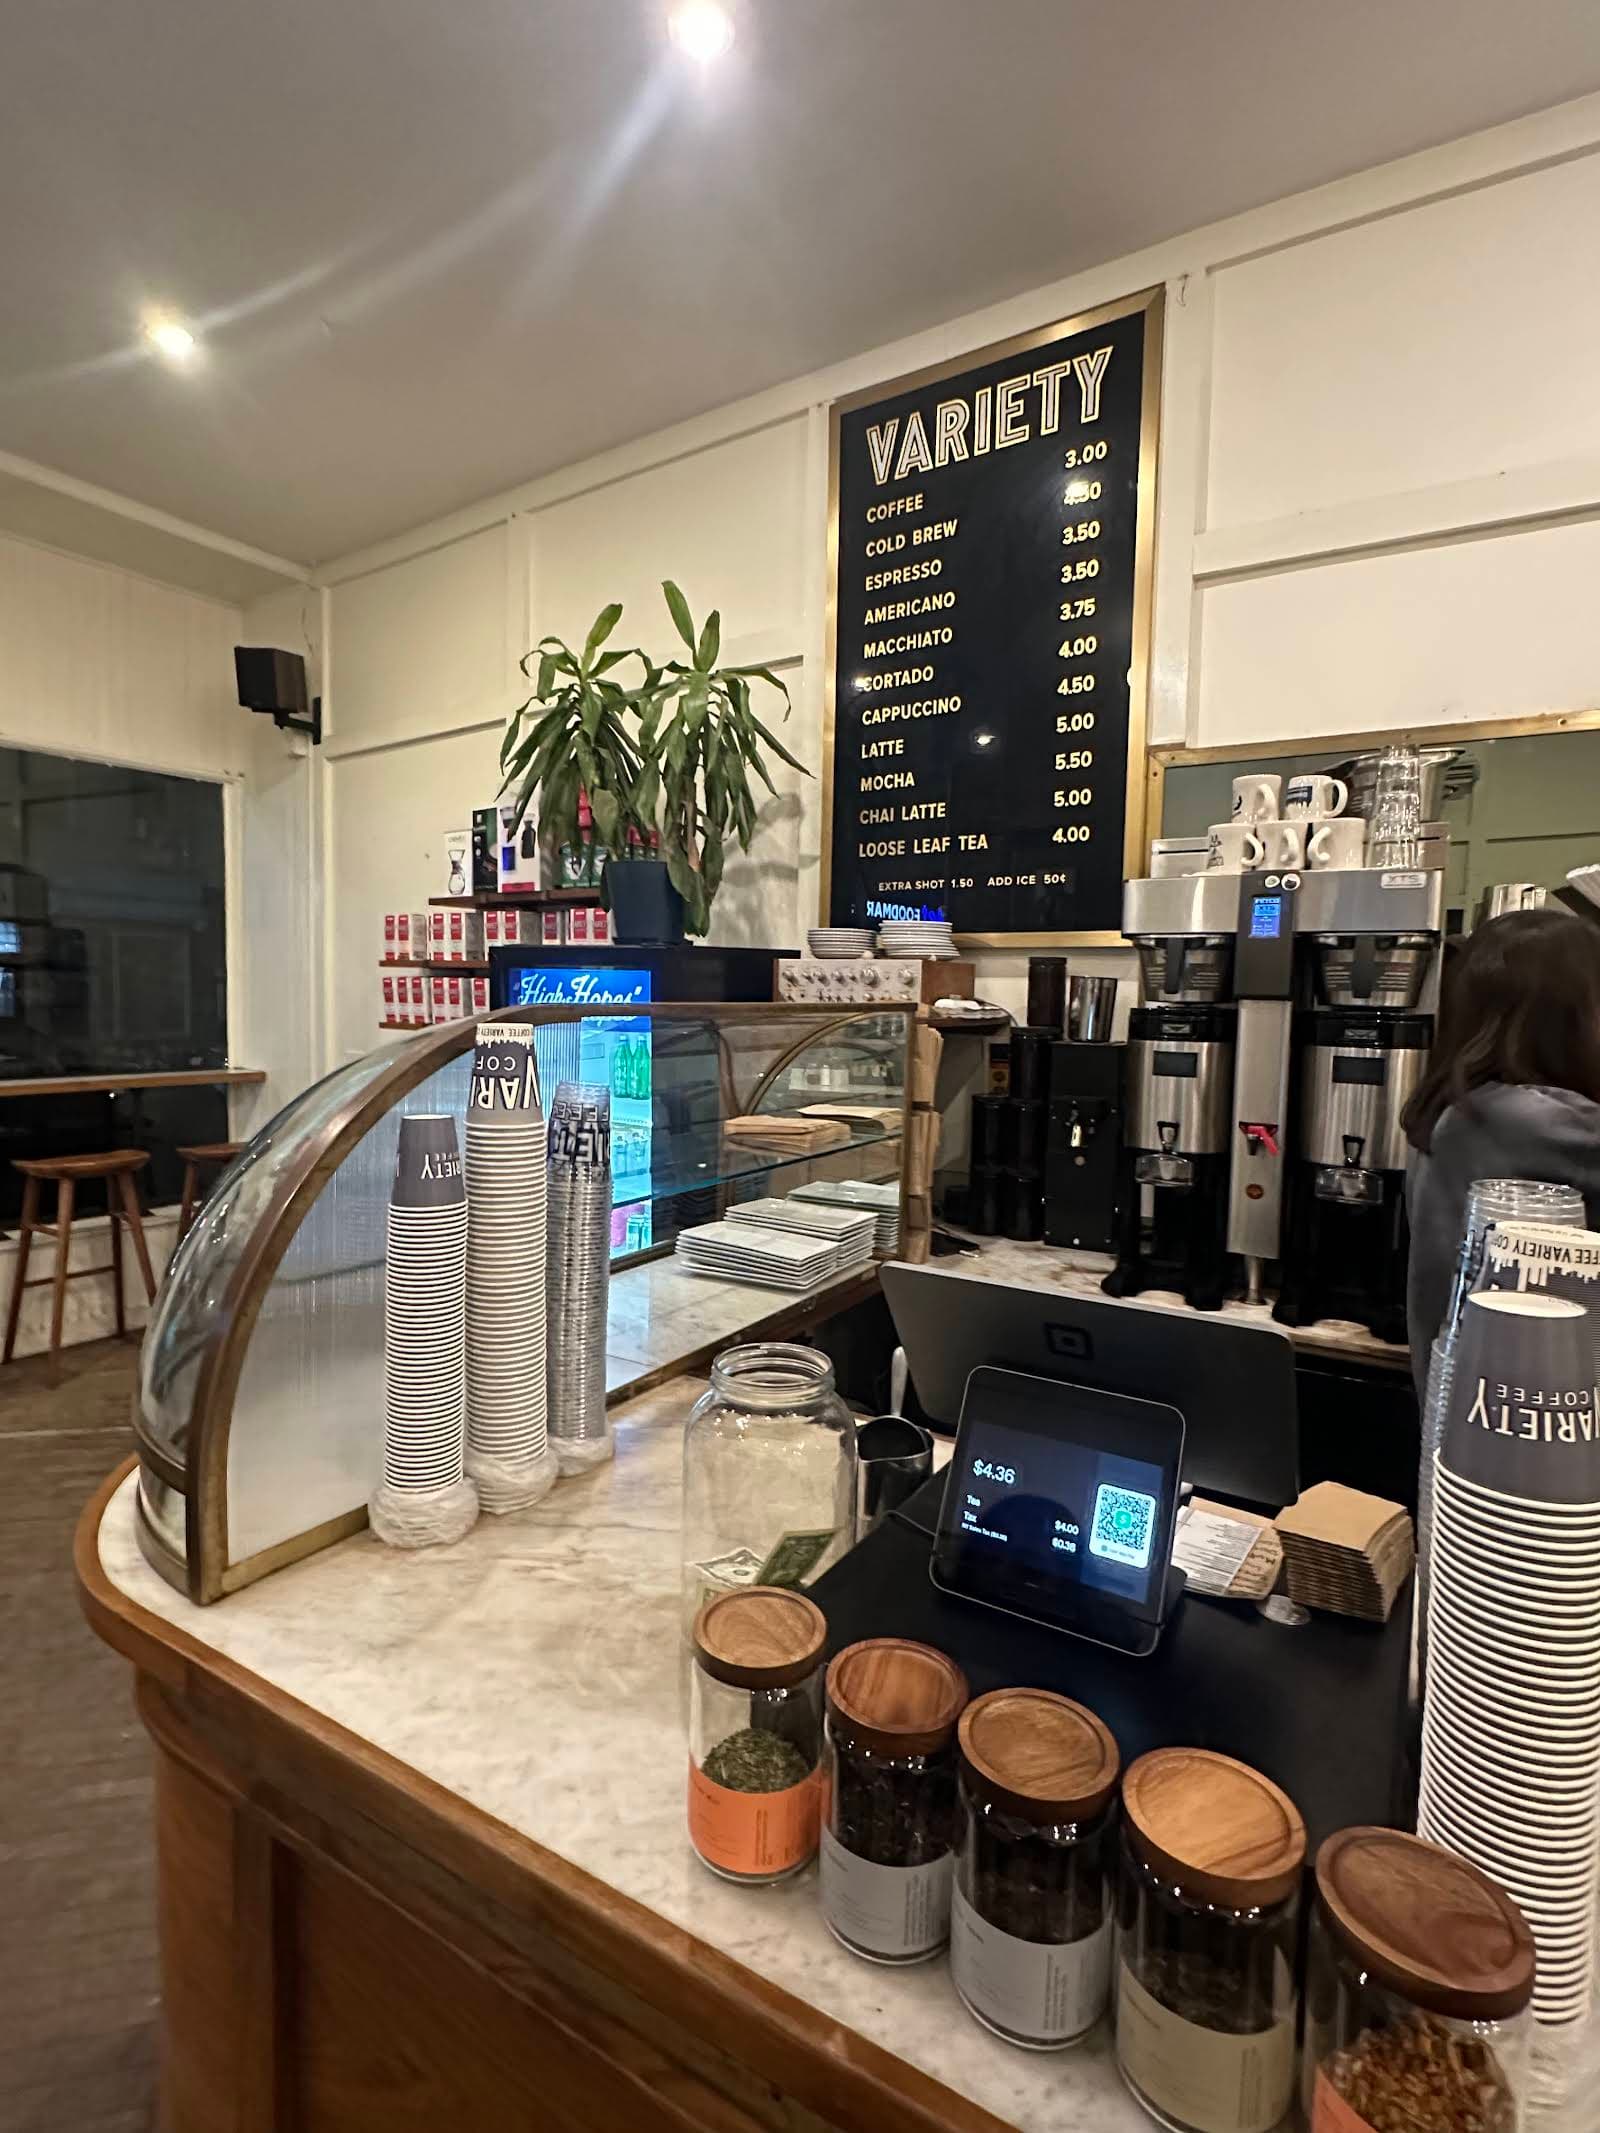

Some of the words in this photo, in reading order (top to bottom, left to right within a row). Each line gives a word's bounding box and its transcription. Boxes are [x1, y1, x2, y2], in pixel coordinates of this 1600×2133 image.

[866, 346, 1114, 486] VARIETY
[865, 493, 924, 523] COFFEE
[1064, 441, 1108, 468] 3.00
[864, 559, 943, 591] ESPRESSO
[1062, 520, 1101, 545] 3.50
[865, 535, 906, 557] COLD
[912, 519, 958, 546] BREW
[864, 591, 956, 625] AMERICANO
[1060, 559, 1099, 583] 3.50
[863, 627, 953, 659] MACCHIATO
[1059, 598, 1096, 621] 3.75
[862, 665, 934, 692] CORTADO
[1058, 635, 1097, 658] 4.00
[861, 695, 961, 726] CAPPUCCINO
[1057, 674, 1095, 695] 4.50
[861, 738, 905, 760] LATTE
[1056, 712, 1095, 734] 5.00
[860, 771, 915, 792] MOCHA
[1054, 750, 1093, 771] 5.50
[859, 807, 895, 825] CHAI
[901, 802, 947, 822] LATTE
[1053, 787, 1092, 808] 5.00
[858, 840, 906, 858] LOOSE
[913, 836, 952, 855] LEAF
[958, 833, 989, 851] TEA
[1052, 825, 1090, 844] 4.00
[878, 880, 913, 892] EXTRA
[915, 879, 945, 890] SHOT
[950, 877, 974, 888] 1.50
[987, 875, 1014, 887] ADD
[1016, 874, 1036, 886] ICE
[1044, 873, 1067, 885] 50¢
[1512, 1239, 1572, 1263] VARIETY
[1496, 1384, 1590, 1407] COFFEE
[972, 1458, 1016, 1485] $4.36
[1055, 1519, 1080, 1536] $4.00
